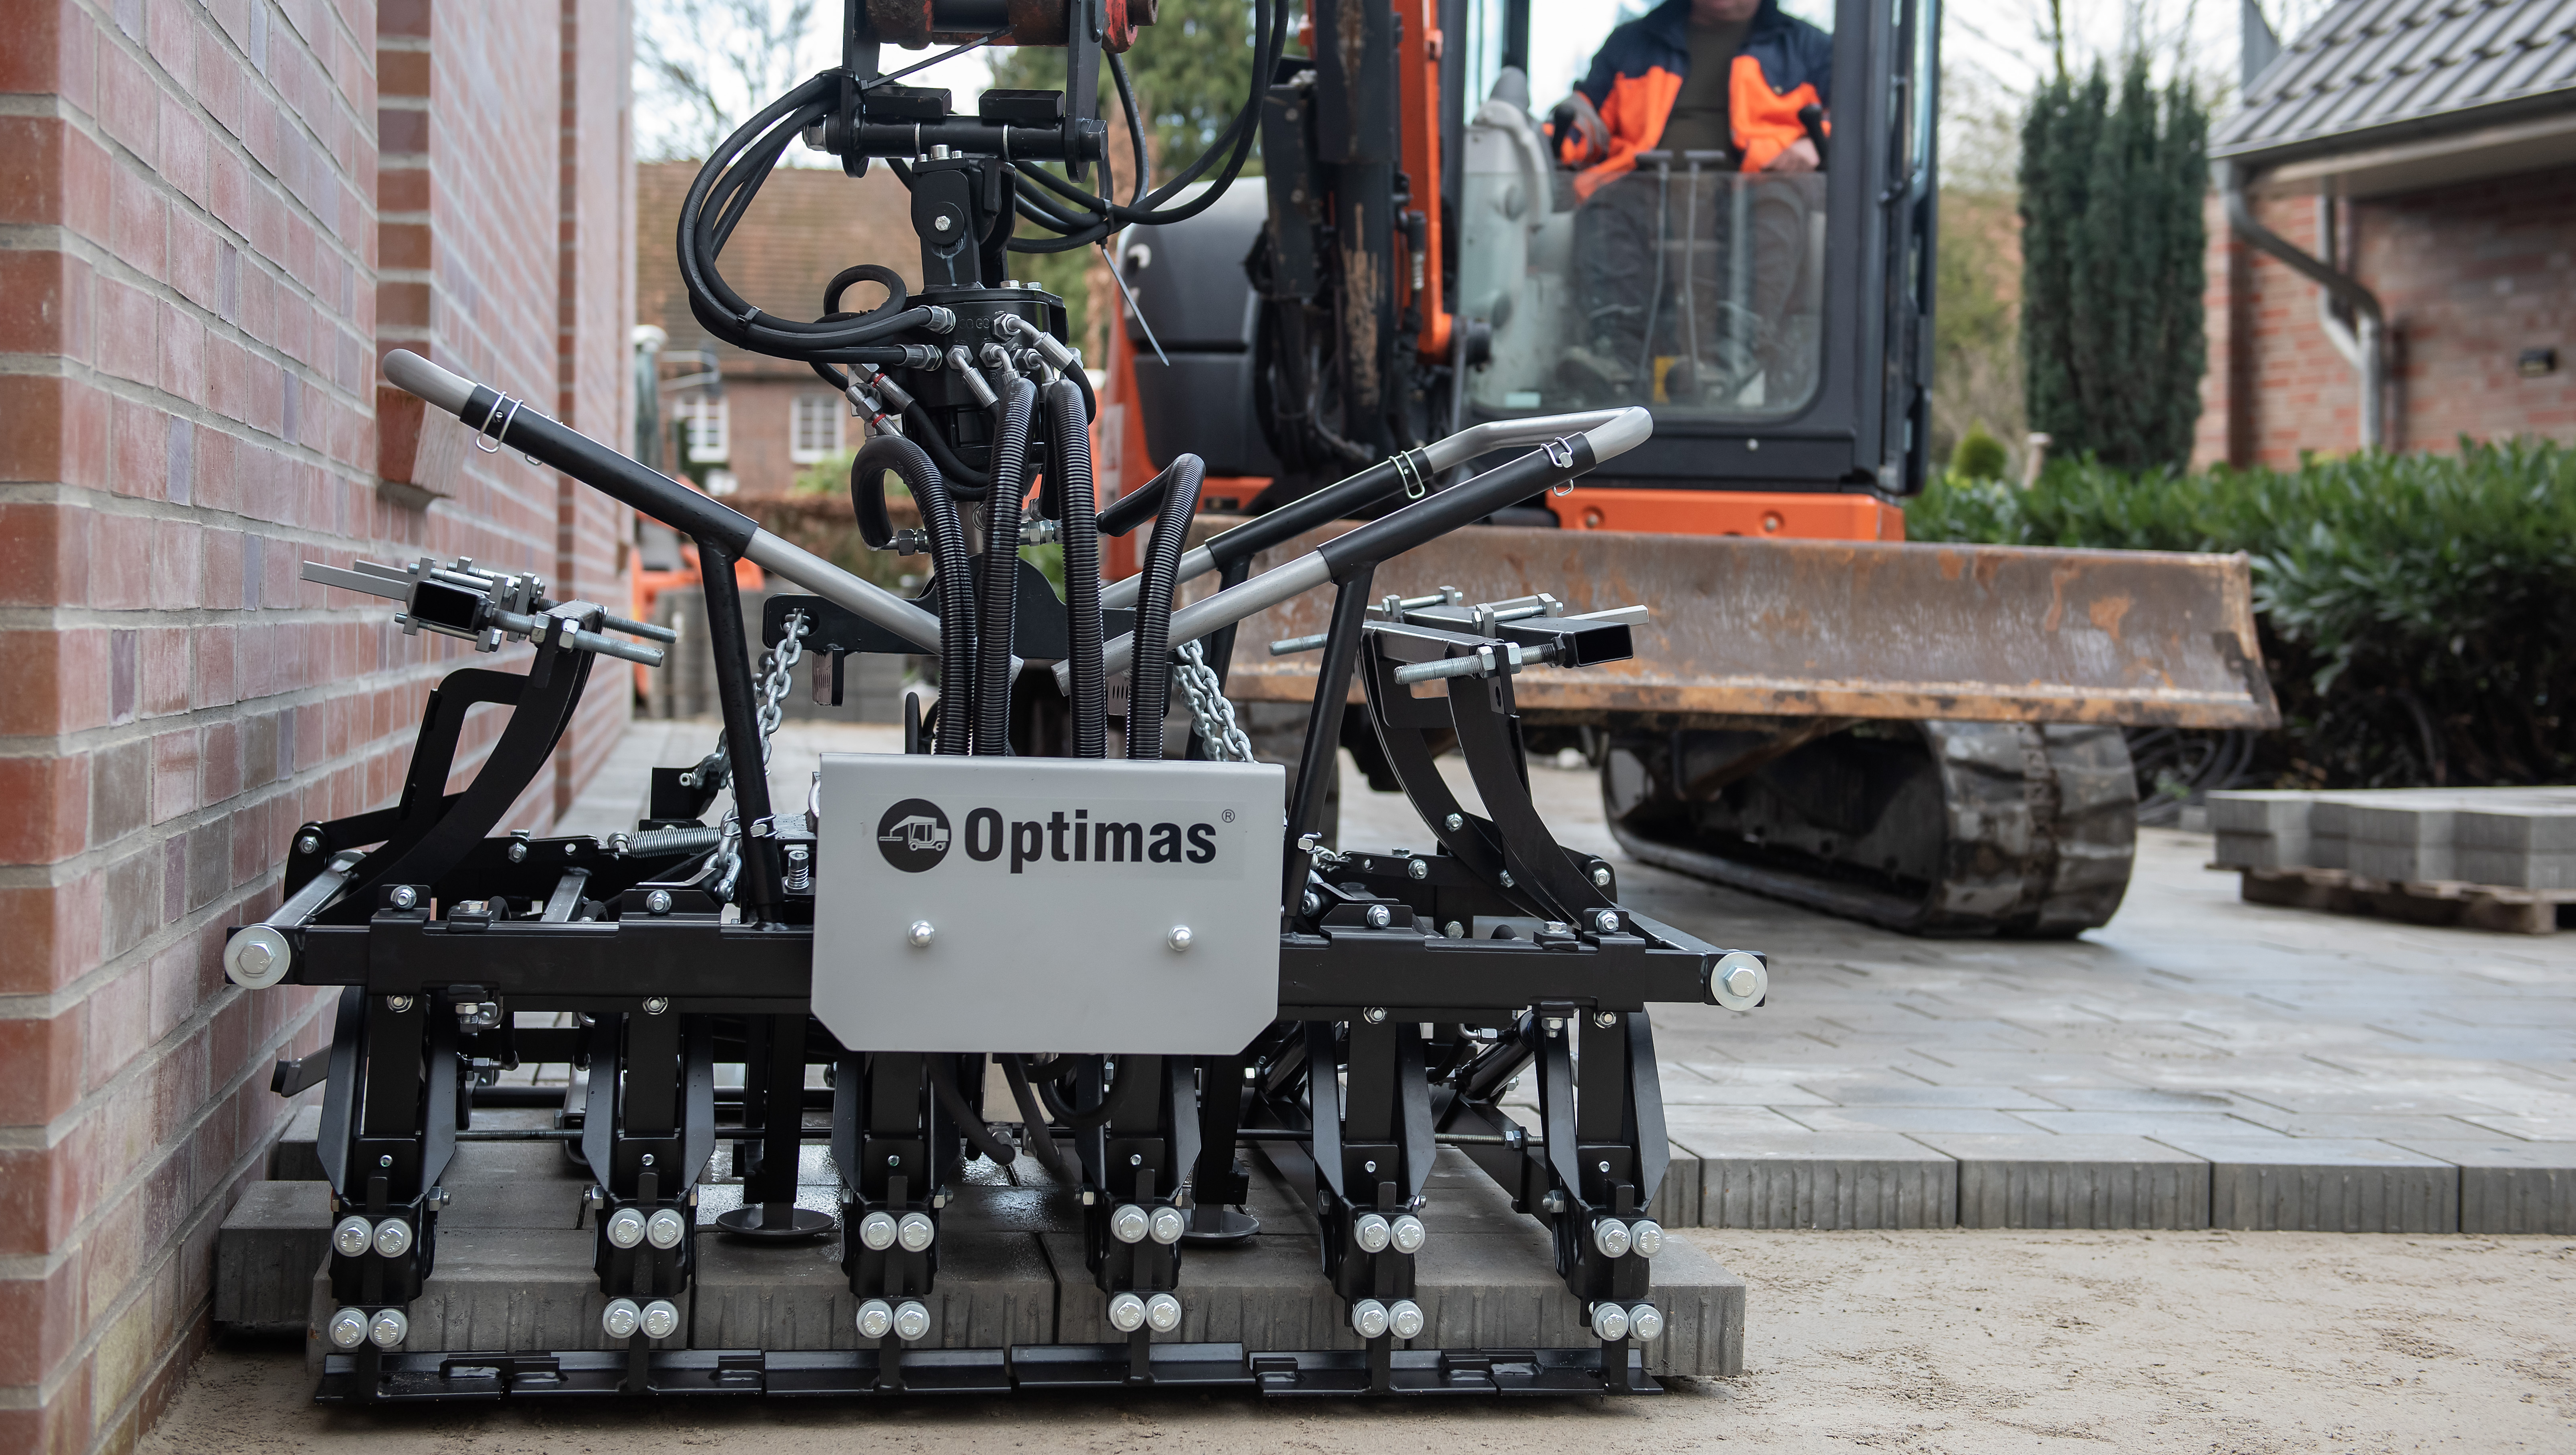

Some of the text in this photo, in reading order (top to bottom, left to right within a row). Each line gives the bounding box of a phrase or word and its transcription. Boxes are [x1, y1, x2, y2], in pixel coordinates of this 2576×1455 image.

[664, 1230, 676, 1242] 8.8
[389, 1240, 401, 1252] 8.8
[1129, 1312, 1140, 1325] 8.8
[337, 1322, 350, 1333] 8.8
[389, 1325, 397, 1338] 8.8
